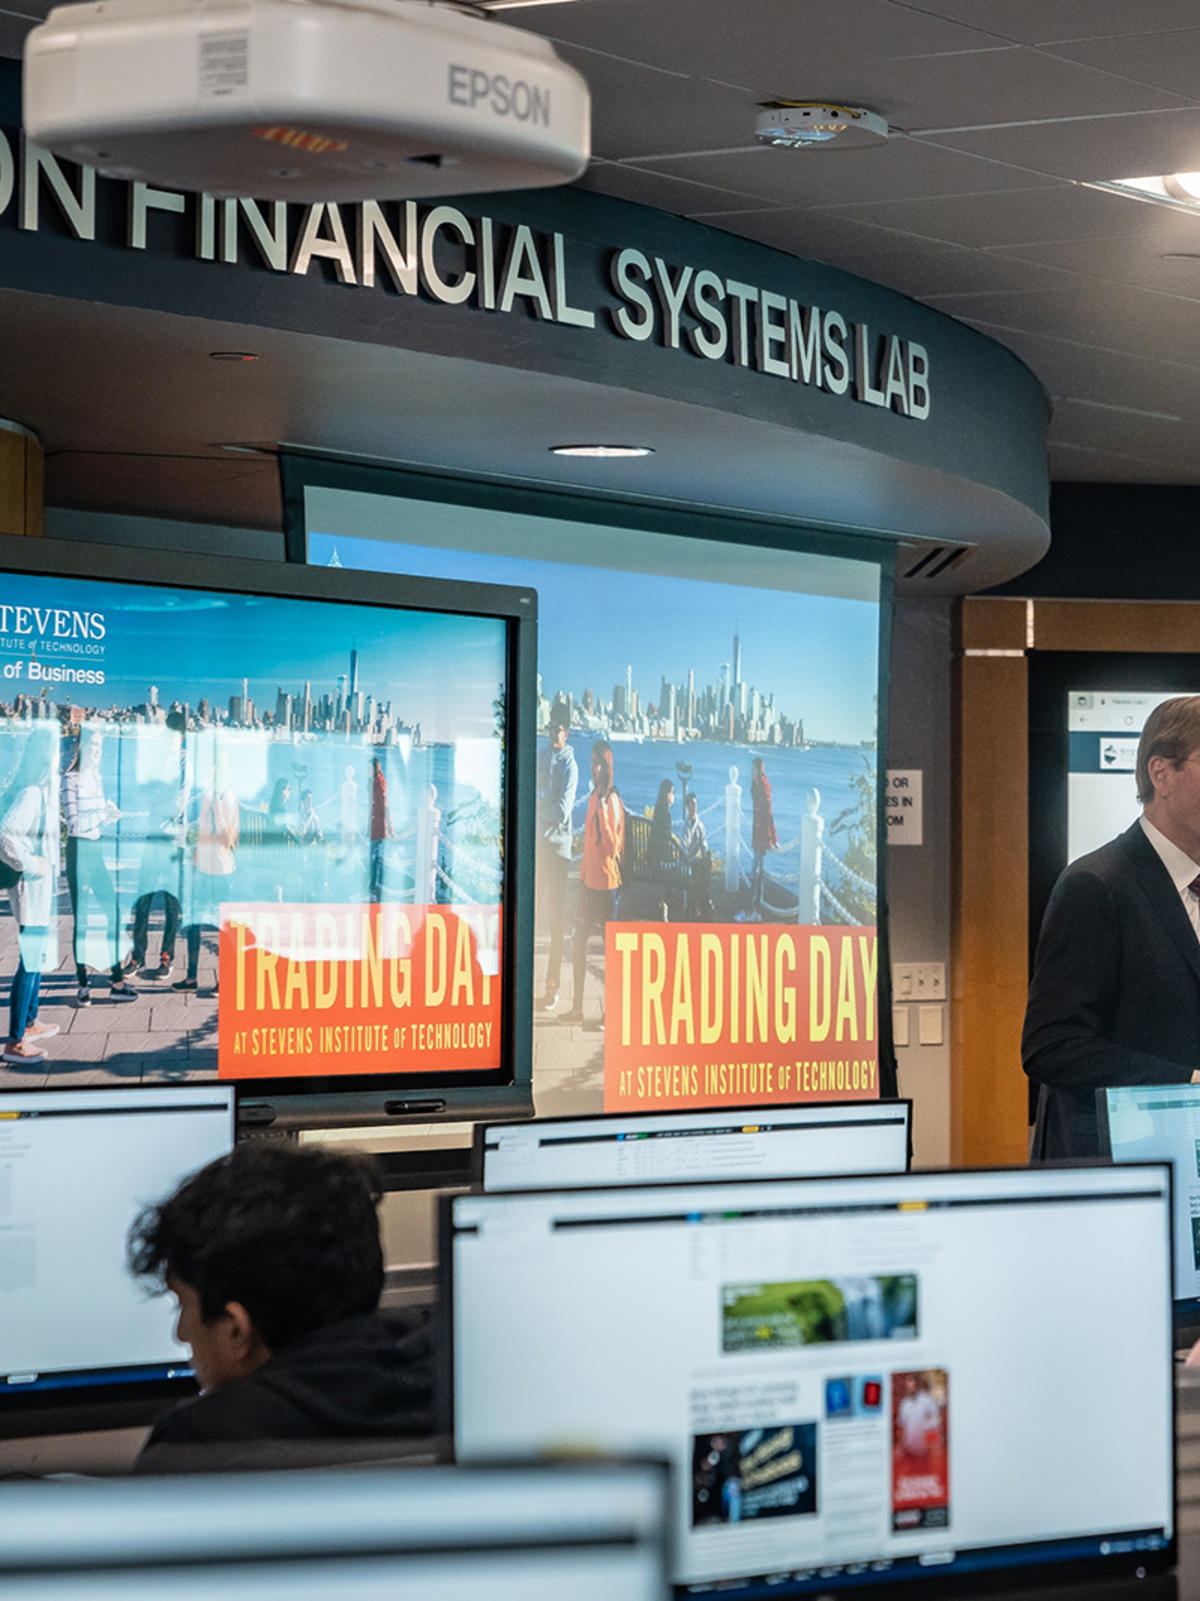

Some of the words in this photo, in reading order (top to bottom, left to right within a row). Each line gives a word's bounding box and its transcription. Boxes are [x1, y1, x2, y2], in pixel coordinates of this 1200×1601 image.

[448, 64, 550, 127] EPSON
[0, 127, 96, 240] N
[130, 181, 595, 328] FINANCIAL
[613, 248, 849, 395] SYSTEMS
[857, 323, 930, 420] LAB
[0, 605, 105, 640] TEVENS
[40, 641, 105, 655] TECHNOLOGY
[3, 661, 23, 679] of
[28, 662, 105, 684] Business
[230, 911, 412, 1011] TRADING
[424, 912, 498, 1007] DAY
[615, 932, 796, 1046] TRADING
[809, 934, 878, 1042] DAY
[234, 1032, 247, 1054] AT
[252, 1027, 313, 1056] STEVENS
[319, 1024, 388, 1053] INSTITUTE
[394, 1027, 406, 1049] OF
[411, 1022, 493, 1050] TECHNOLOGY
[619, 1070, 632, 1096] AT
[637, 1065, 698, 1098] STEVENS
[704, 1063, 773, 1095] INSTITUTE
[778, 1065, 791, 1090] OF
[795, 1060, 876, 1092] TECHNOLOGY
